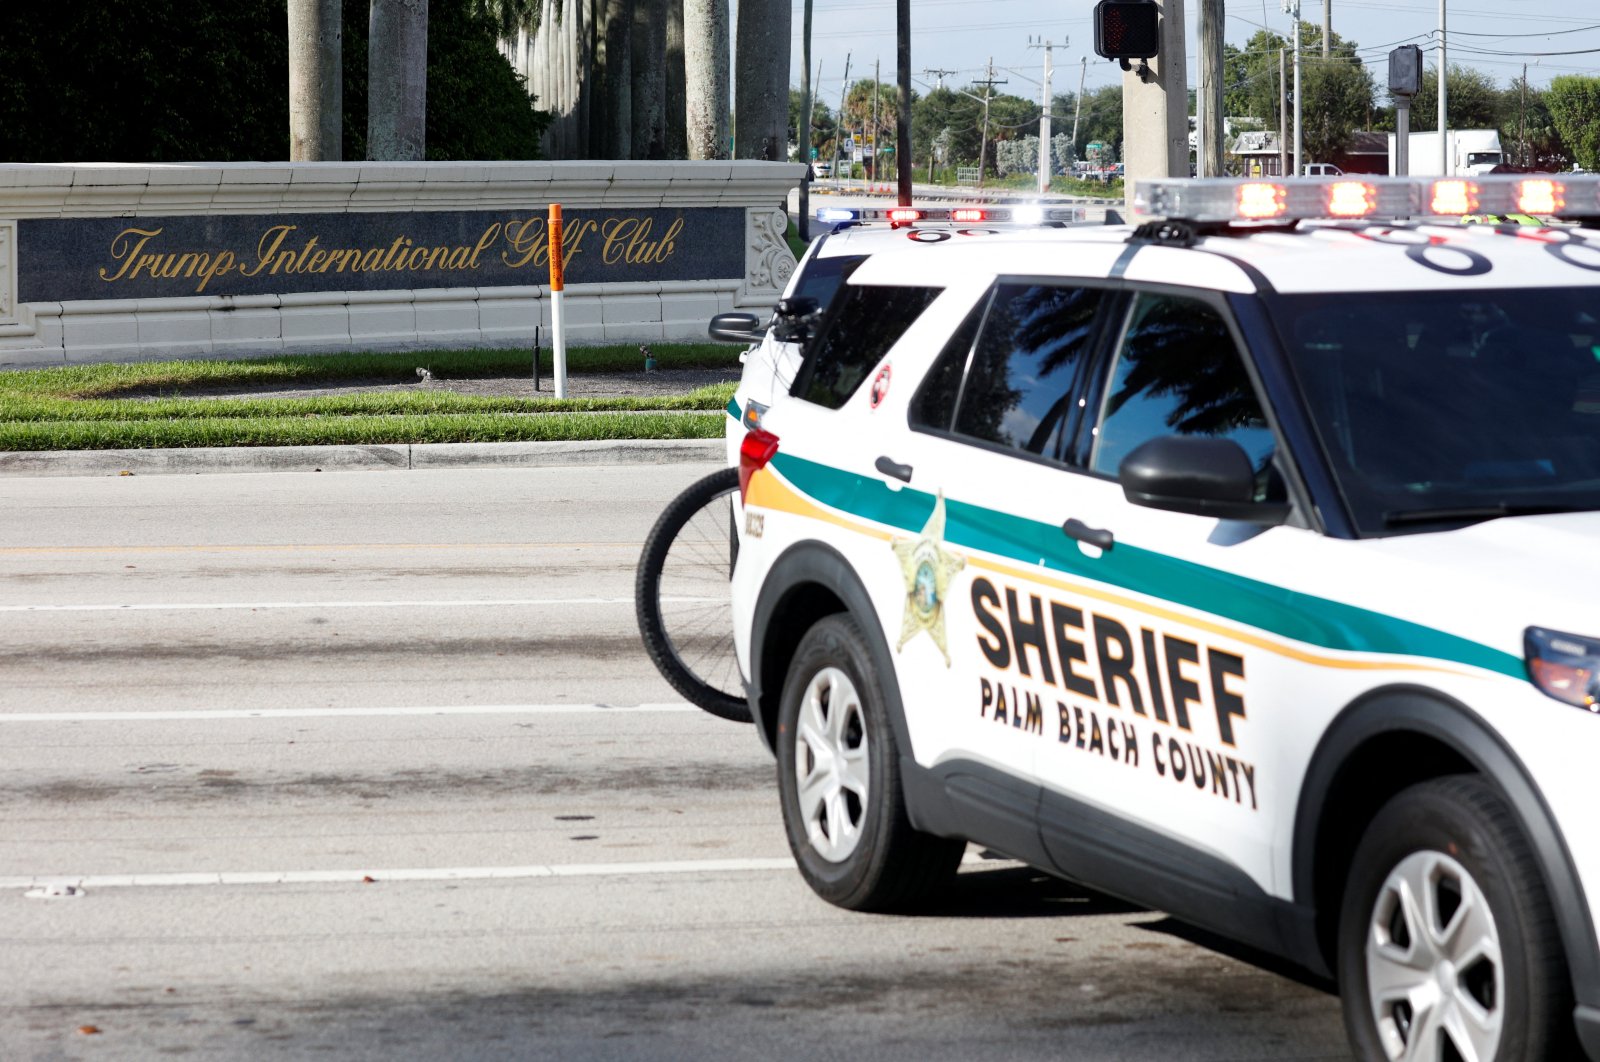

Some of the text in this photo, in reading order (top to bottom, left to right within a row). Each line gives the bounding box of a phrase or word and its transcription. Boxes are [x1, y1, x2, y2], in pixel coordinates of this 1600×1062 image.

[99, 227, 237, 293] Trump
[239, 222, 501, 277] International
[601, 217, 684, 266] Club
[970, 574, 1248, 749] SHERIFF
[979, 676, 1259, 811] PALM BEACH COUNTY
